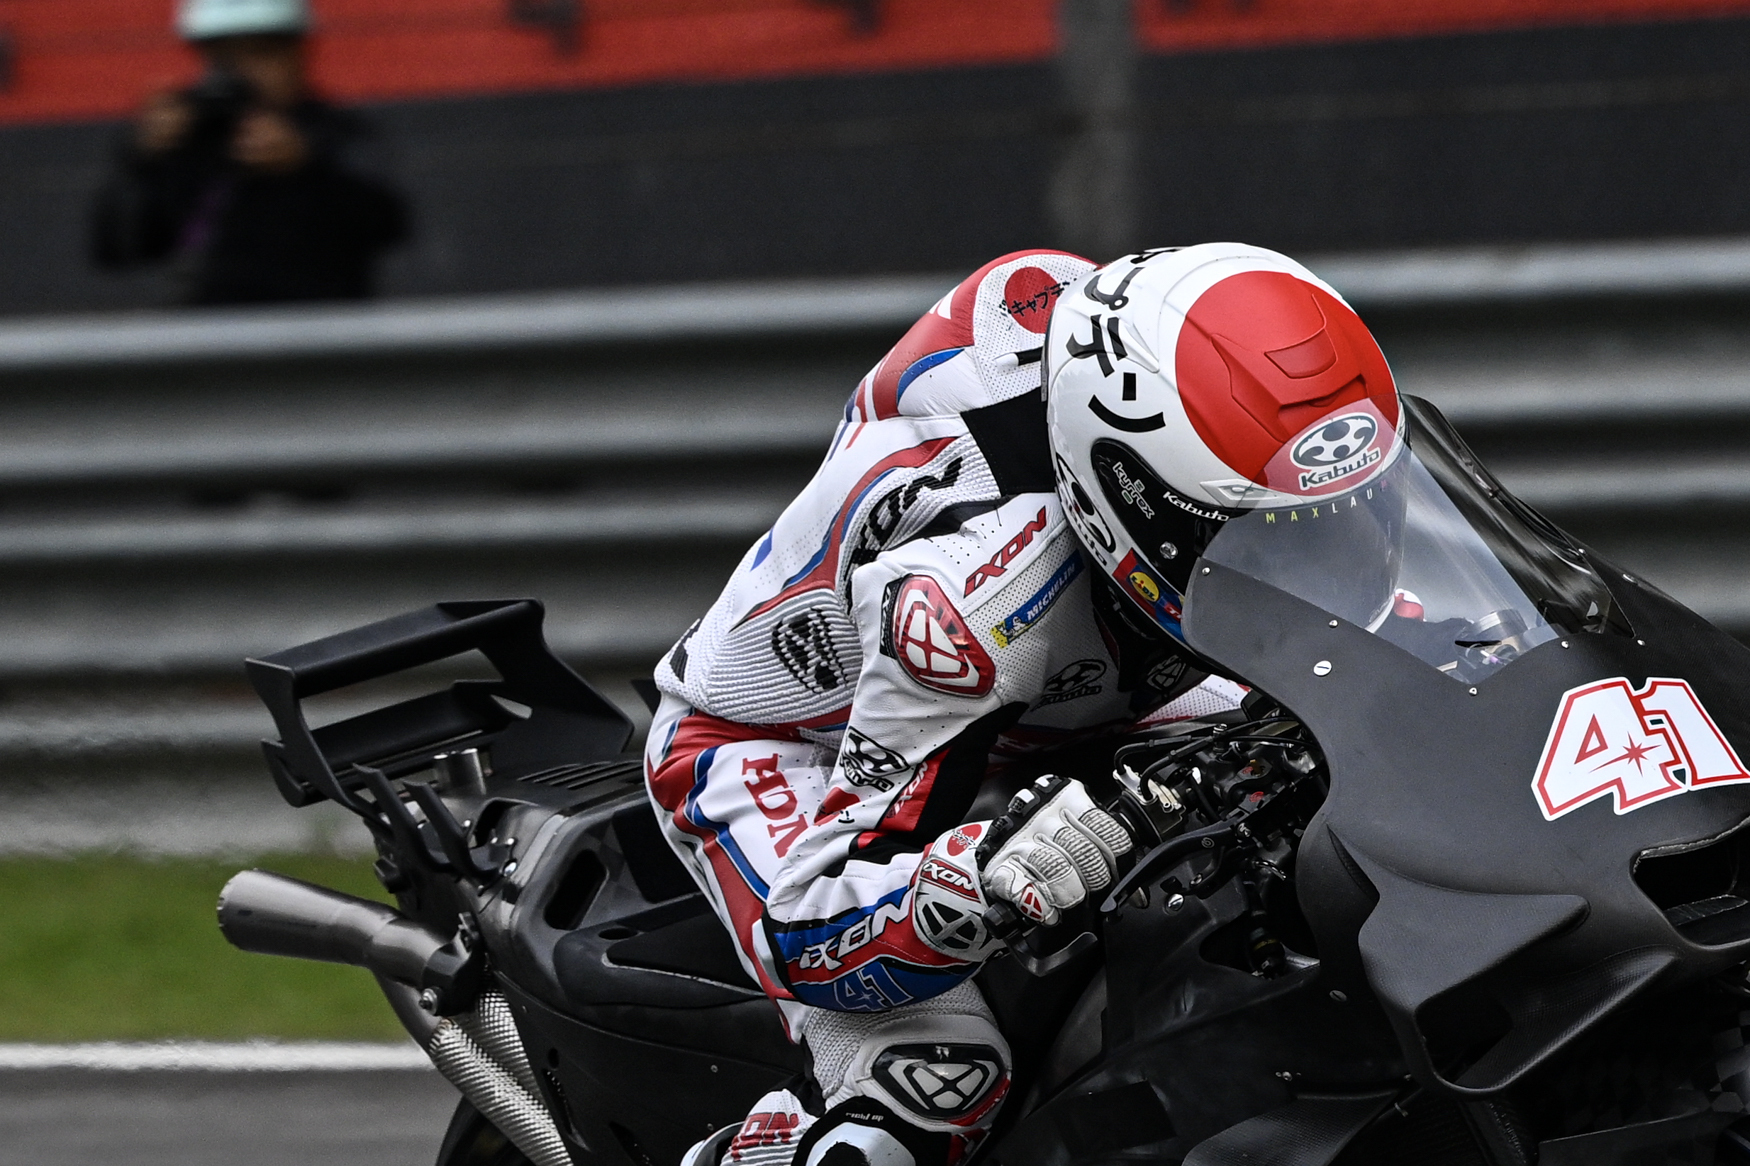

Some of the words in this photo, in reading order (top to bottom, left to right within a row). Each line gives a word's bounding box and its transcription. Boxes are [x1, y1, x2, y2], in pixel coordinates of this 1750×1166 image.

[1300, 449, 1381, 489] Kabuto
[1163, 491, 1231, 522] Kabuto
[963, 505, 1048, 599] IXON
[1026, 563, 1077, 623] MICHELIN
[798, 886, 916, 972] IXON
[833, 960, 914, 1012] 41
